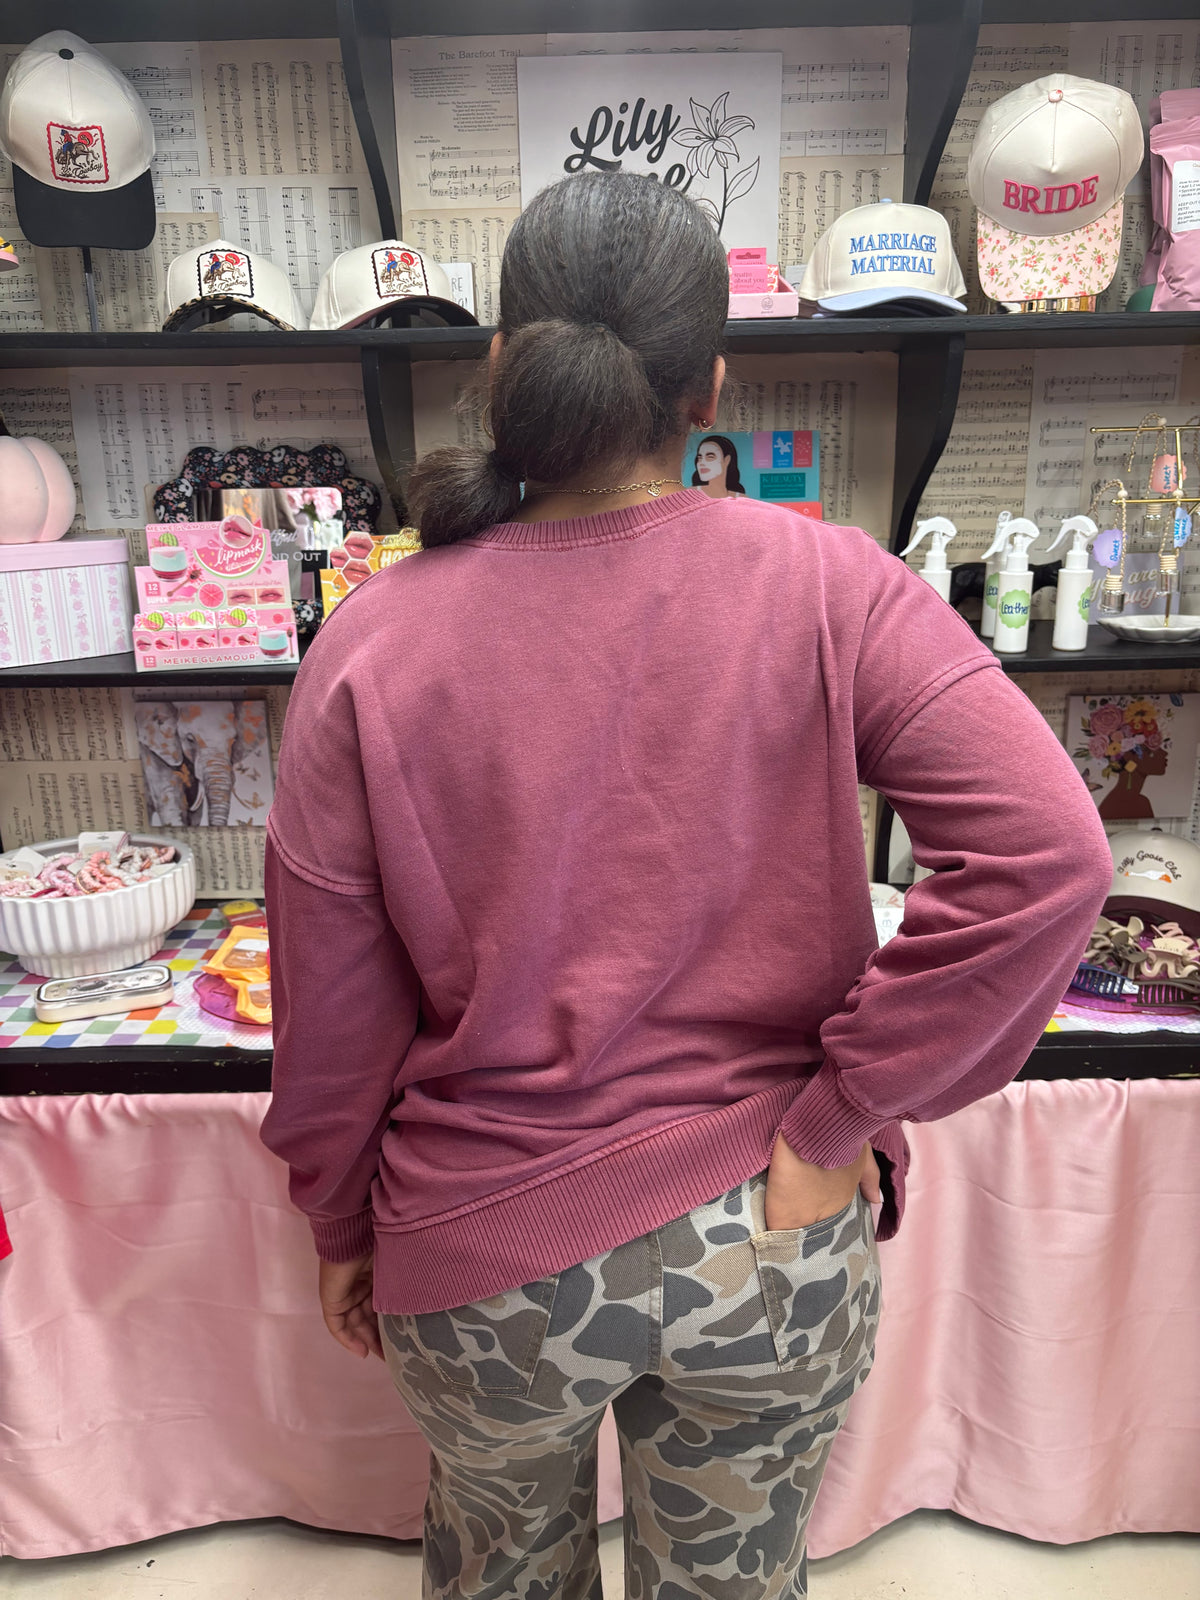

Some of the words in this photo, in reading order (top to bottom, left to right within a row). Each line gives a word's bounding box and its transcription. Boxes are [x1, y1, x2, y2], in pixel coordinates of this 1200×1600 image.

[439, 52, 456, 60] The
[458, 49, 497, 60] Barefoot
[564, 97, 681, 173] Lily
[1002, 174, 1099, 215] BRIDE
[849, 233, 937, 254] MARRIAGE
[850, 255, 936, 275] MATERIAL
[271, 552, 289, 562] ND
[292, 551, 321, 562] OUT
[1128, 568, 1159, 585] are
[147, 583, 159, 591] 12
[144, 656, 155, 664] 12
[1136, 850, 1164, 862] Goose
[1165, 861, 1182, 880] Club
